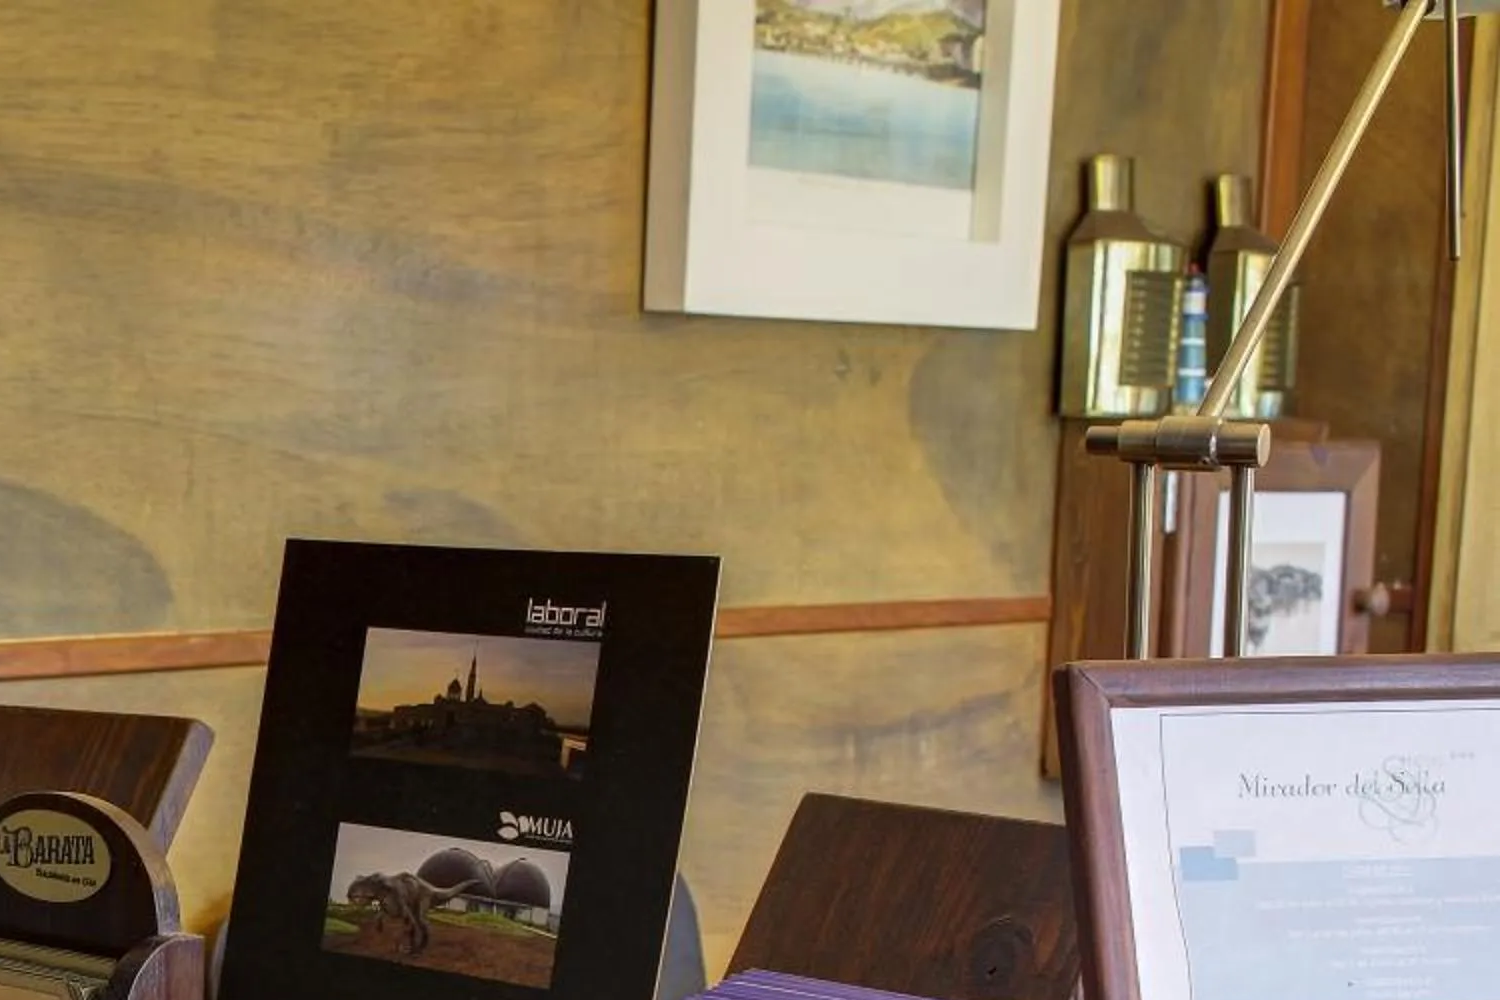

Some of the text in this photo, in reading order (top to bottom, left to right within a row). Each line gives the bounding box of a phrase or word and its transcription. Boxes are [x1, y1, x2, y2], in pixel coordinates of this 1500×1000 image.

[527, 597, 607, 627] laboral
[1238, 772, 1337, 799] Mirador
[1345, 771, 1380, 797] del
[529, 815, 574, 840] MUJA
[2, 826, 95, 869] BARATA
